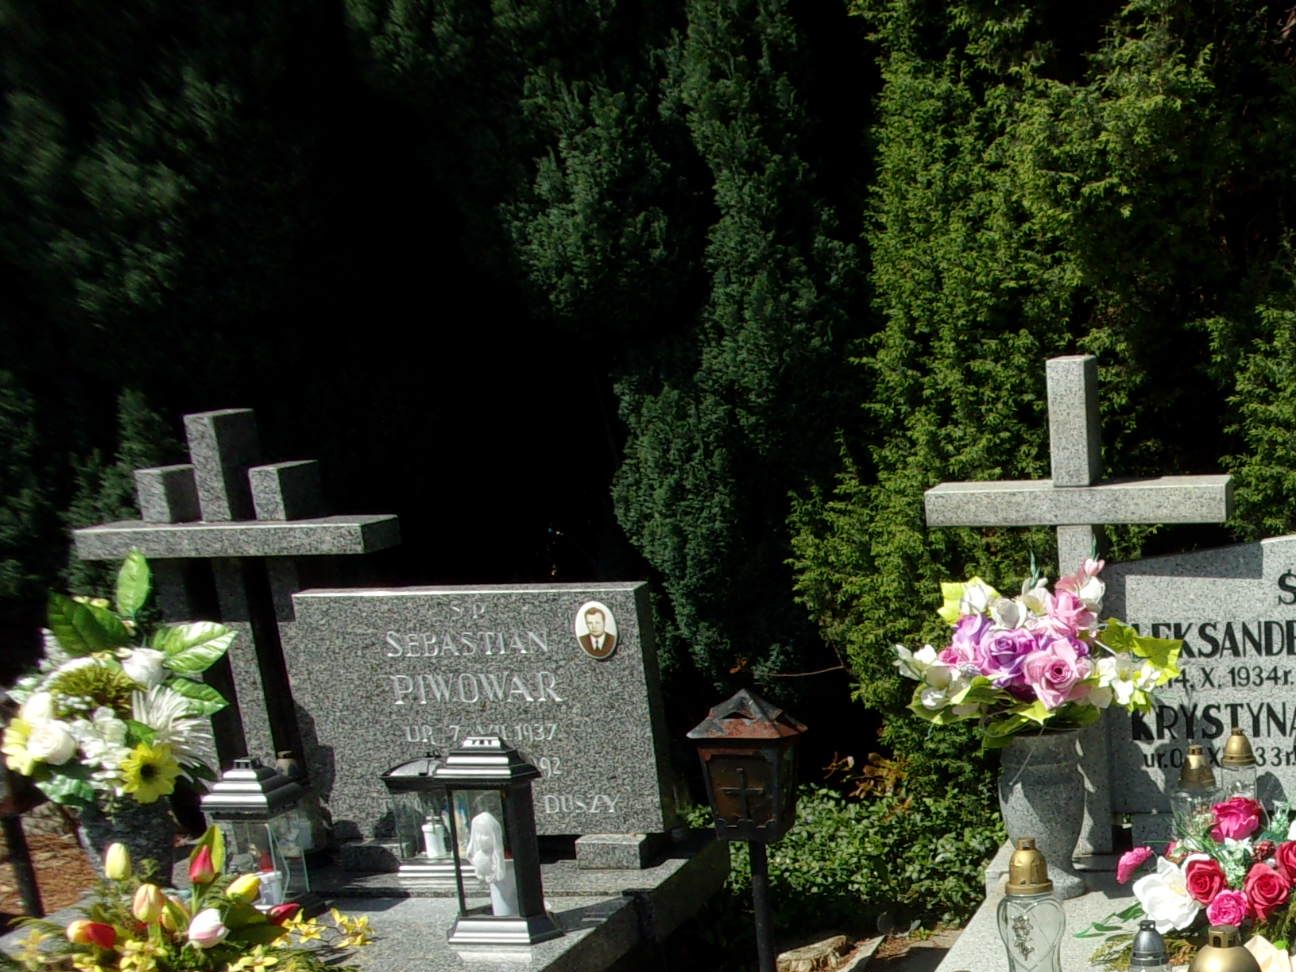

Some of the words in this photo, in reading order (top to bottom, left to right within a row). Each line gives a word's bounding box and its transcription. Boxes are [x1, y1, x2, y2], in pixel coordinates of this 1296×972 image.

[386, 630, 550, 657] SEBASTIAN
[390, 671, 563, 705] PIWOWAR
[1228, 665, 1294, 688] 1934r.
